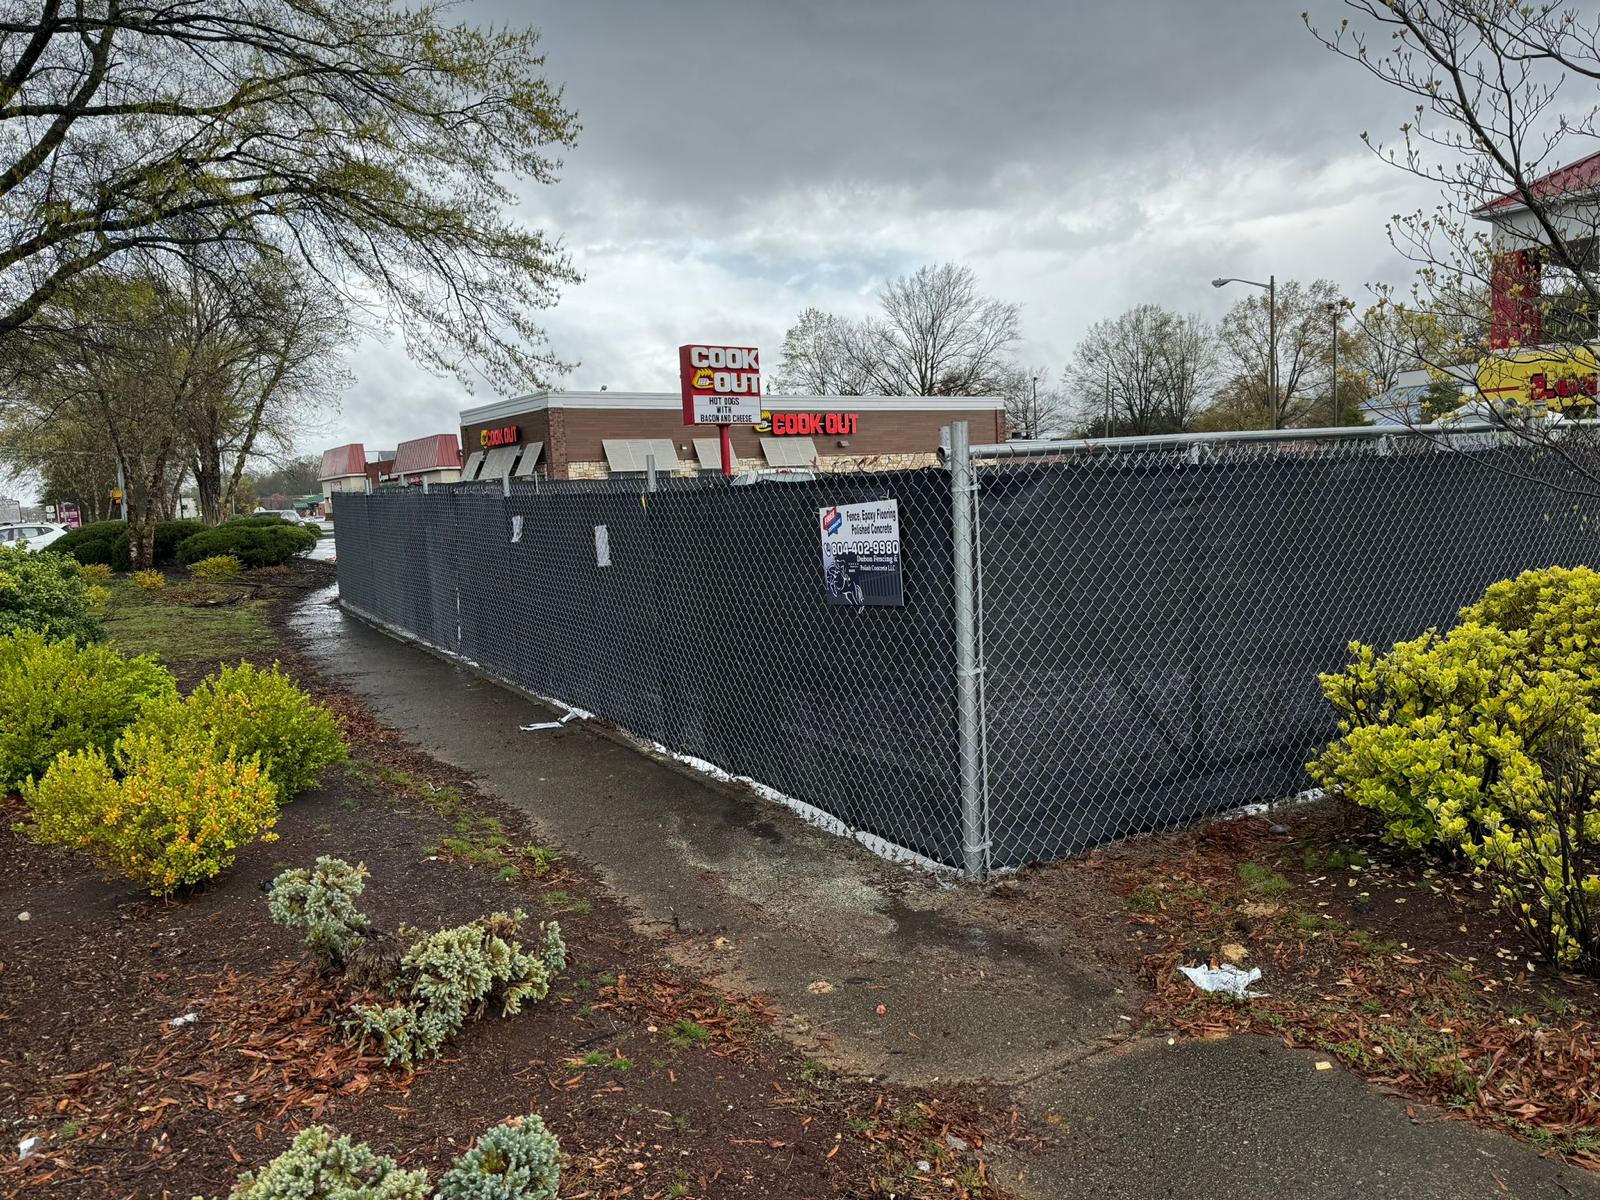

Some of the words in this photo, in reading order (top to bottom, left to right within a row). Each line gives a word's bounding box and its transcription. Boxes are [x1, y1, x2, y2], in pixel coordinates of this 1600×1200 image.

[691, 347, 760, 369] COOK
[714, 372, 761, 393] OUT
[709, 397, 721, 405] HOT
[724, 397, 740, 406] DOGS
[716, 406, 732, 414] WITH
[700, 414, 720, 422] BACON
[720, 414, 731, 422] AND
[732, 414, 752, 423] CHEESE
[772, 413, 824, 435] COOK
[825, 413, 859, 434] OUT
[486, 427, 504, 446] COOK
[504, 425, 517, 443] OUT
[846, 511, 861, 523] Fence,
[862, 509, 876, 523] Epoxy
[877, 505, 896, 521] Flooring
[852, 524, 870, 535] Polished
[871, 523, 892, 534] Concrete
[831, 541, 899, 556] 804-402-9980
[873, 554, 893, 564] Fencing
